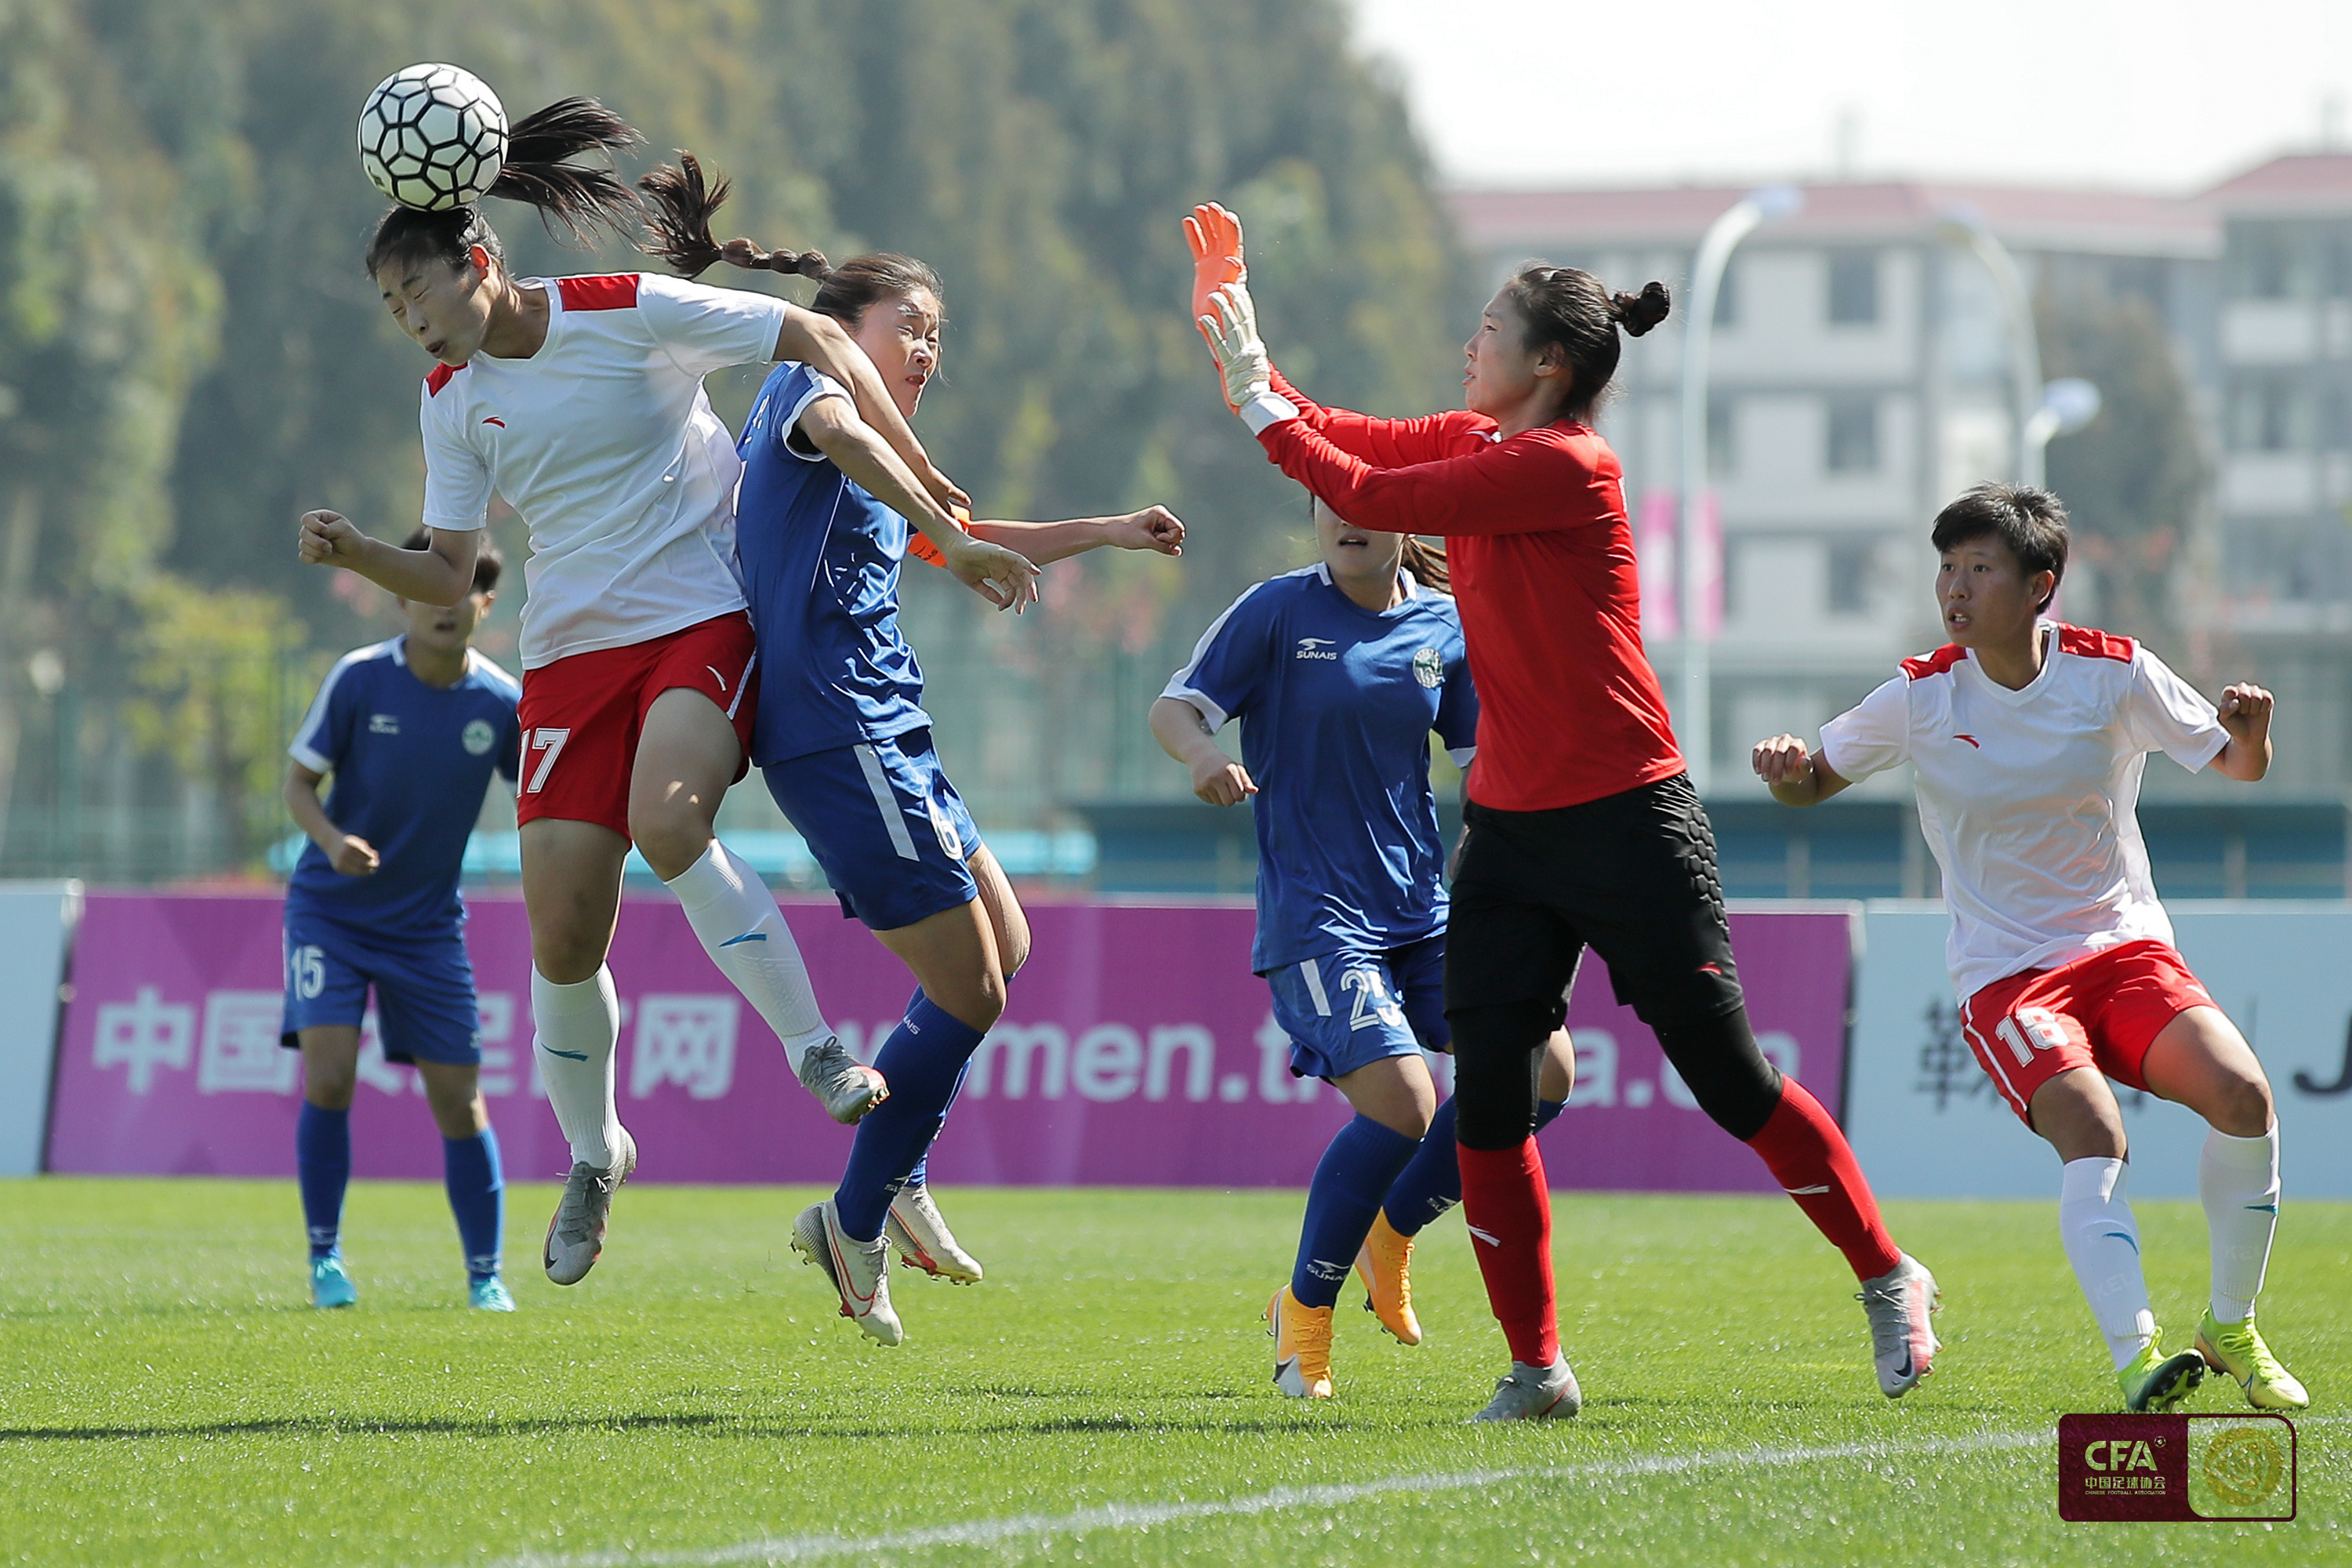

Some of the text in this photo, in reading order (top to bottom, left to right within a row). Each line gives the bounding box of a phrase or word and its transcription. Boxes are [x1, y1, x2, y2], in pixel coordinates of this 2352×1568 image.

[1296, 650, 1337, 660] SUNAIS
[516, 728, 571, 798] 17
[290, 946, 325, 1001] 15
[1995, 1007, 2070, 1068] 16
